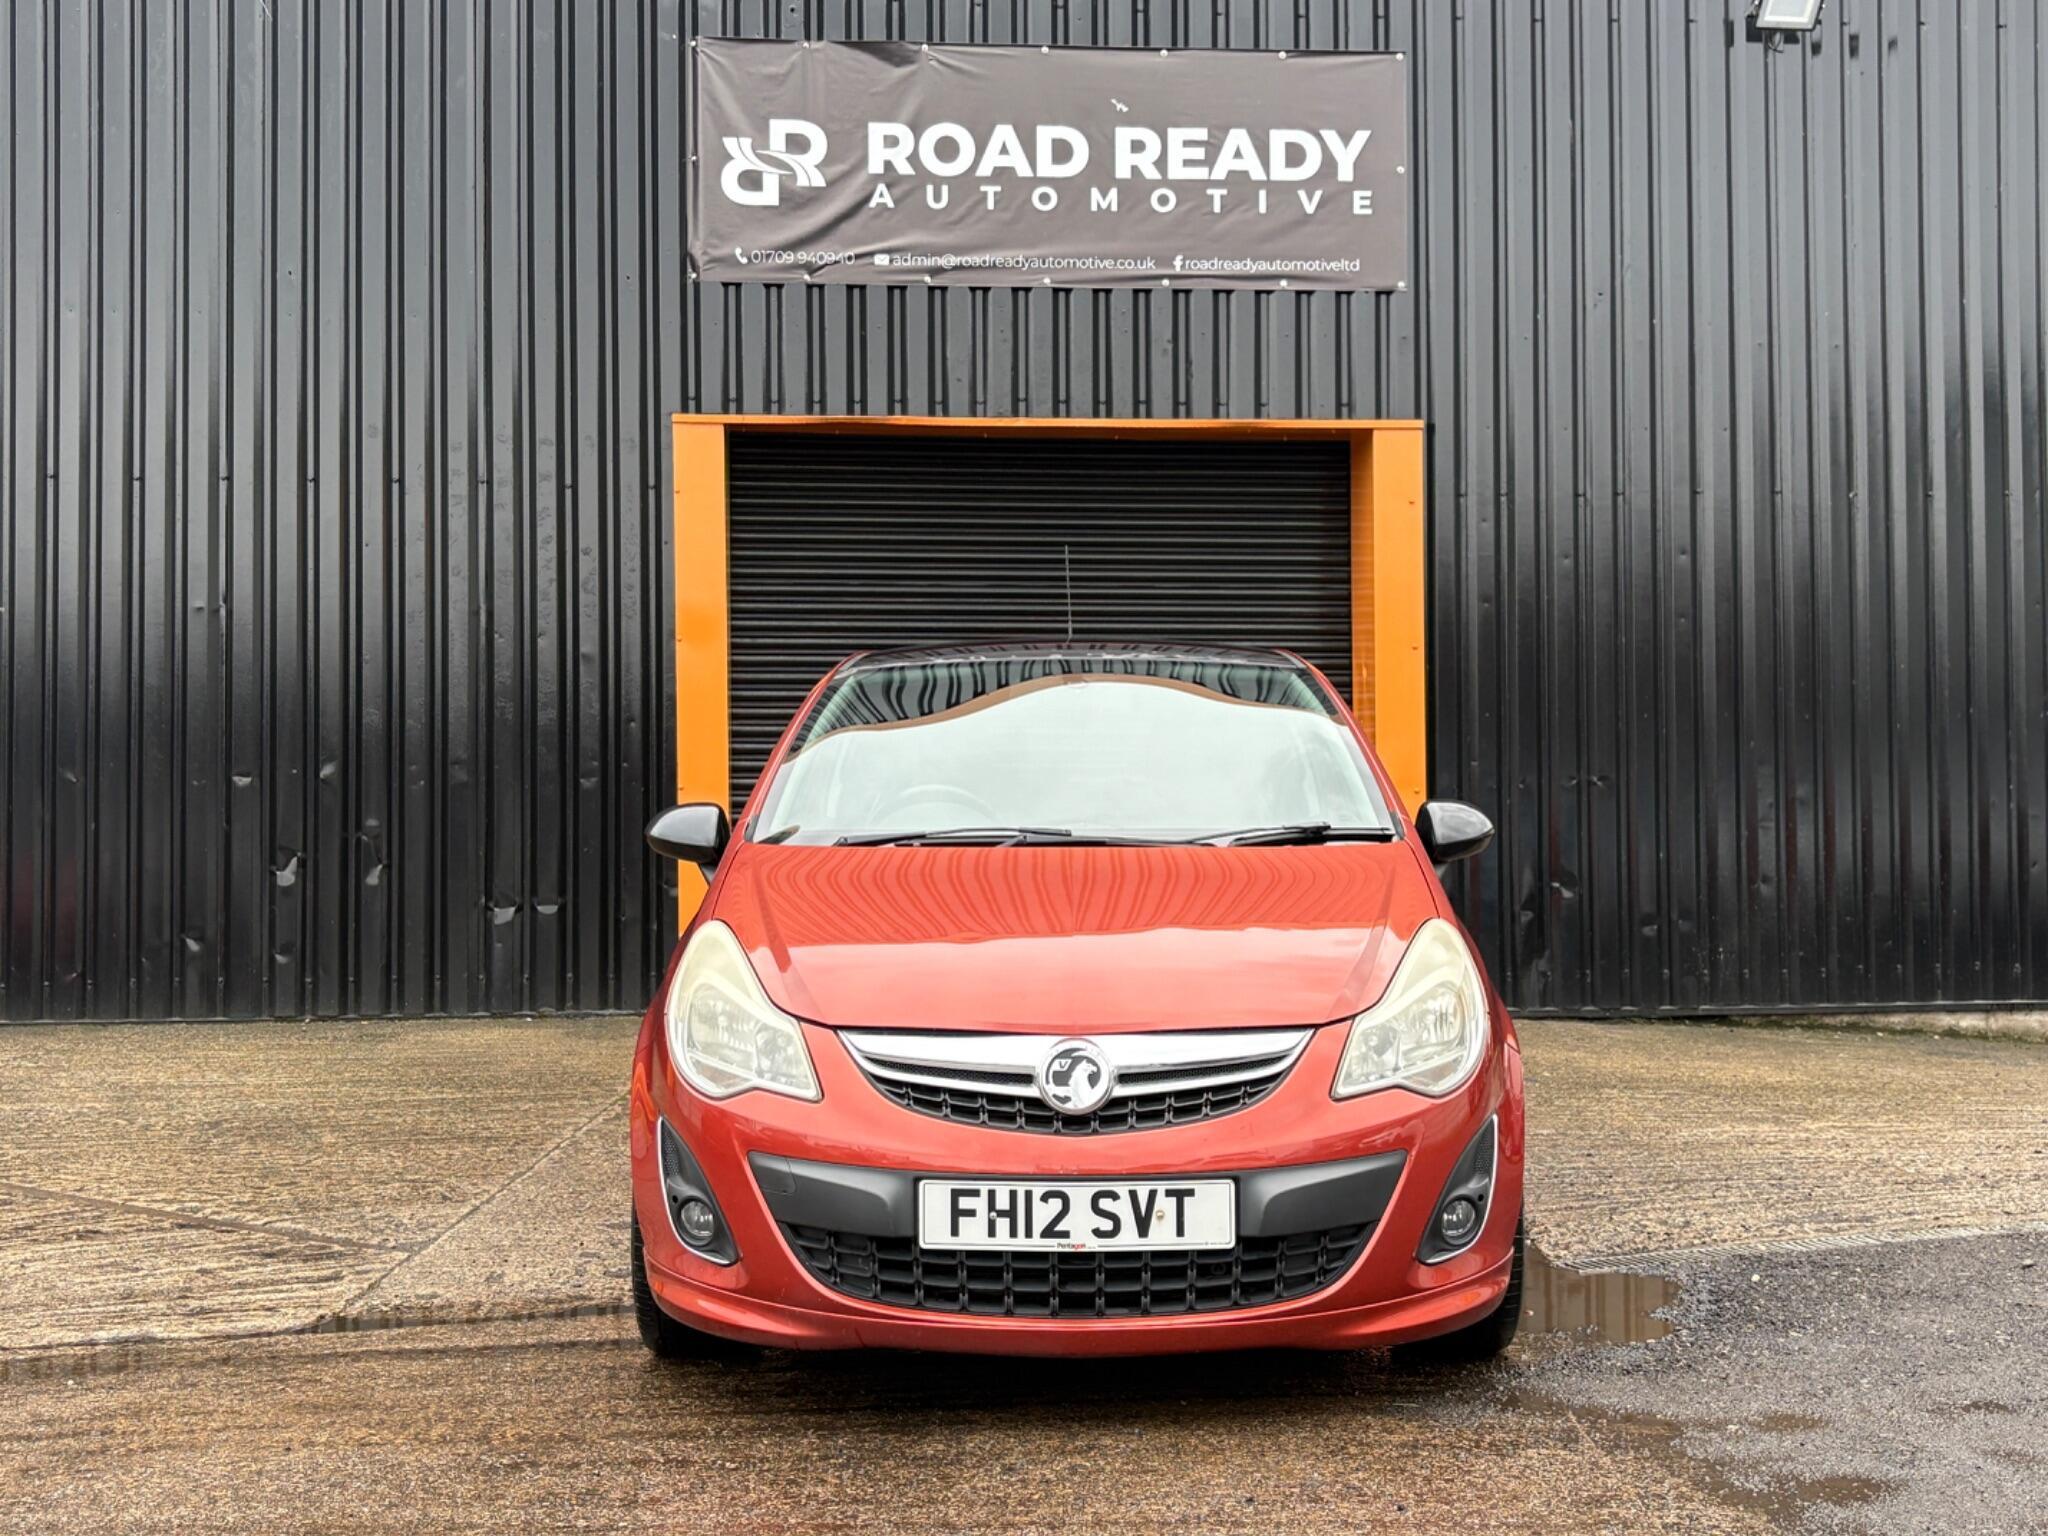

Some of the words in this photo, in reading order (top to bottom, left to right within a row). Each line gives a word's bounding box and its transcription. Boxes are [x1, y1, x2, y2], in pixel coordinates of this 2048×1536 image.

[867, 121, 1090, 178] ROAD
[1115, 126, 1372, 183] READY
[868, 183, 1373, 216] AUTOMOTIVE
[751, 250, 794, 264] 01709
[892, 253, 1157, 272] admin@roadreadyautomotive.co.uk
[1185, 257, 1361, 273] roadreadyautomotiveltd
[950, 1188, 1071, 1239] FH12
[1090, 1188, 1195, 1239] SVT
